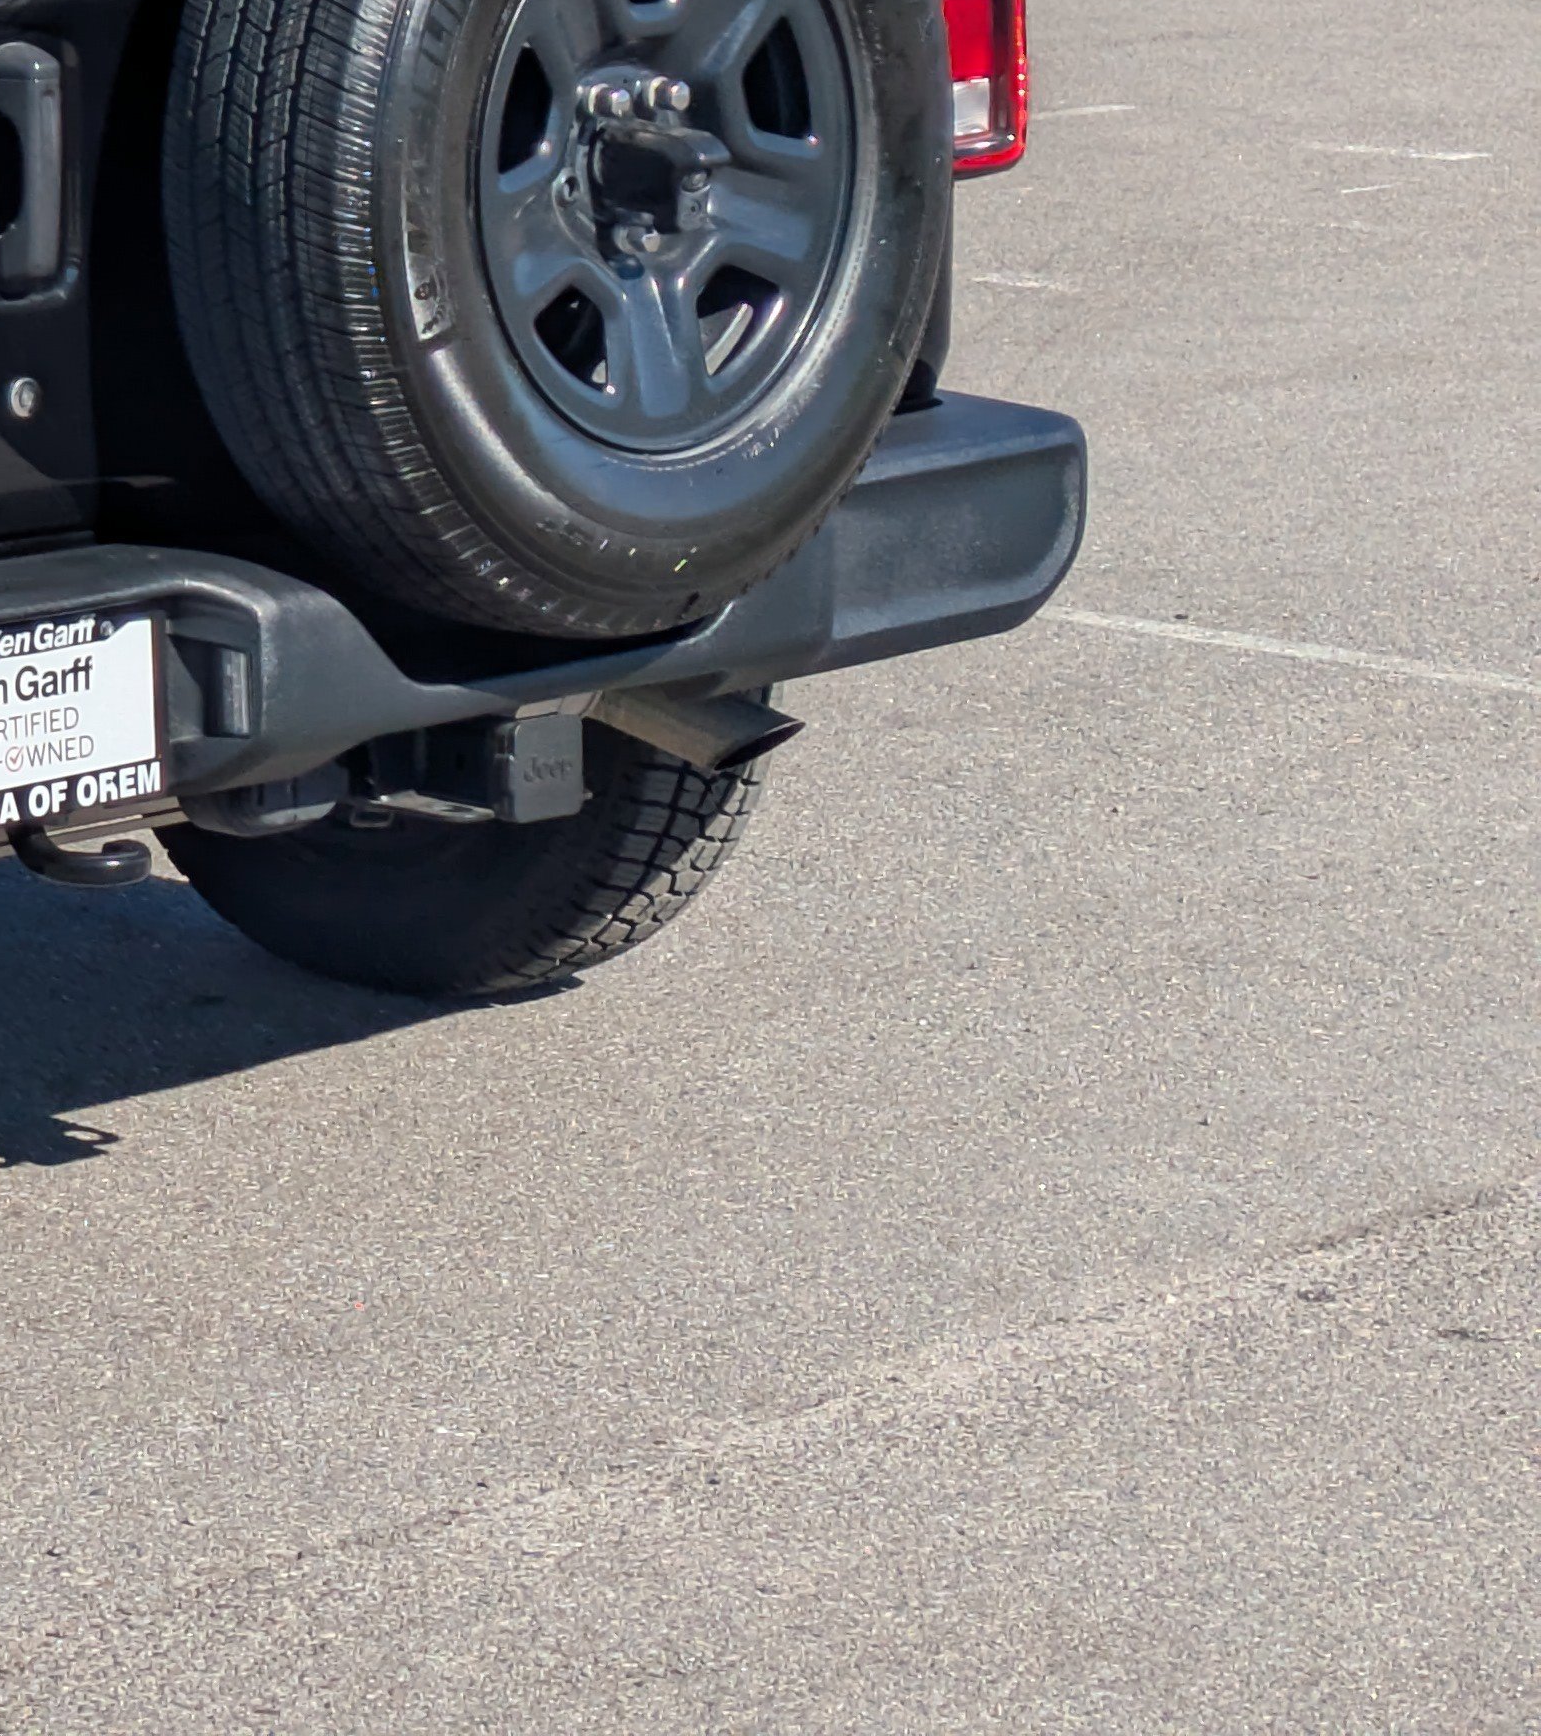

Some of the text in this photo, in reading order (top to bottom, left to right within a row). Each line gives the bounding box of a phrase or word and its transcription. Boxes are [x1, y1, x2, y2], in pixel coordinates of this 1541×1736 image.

[32, 615, 97, 651] Garff
[15, 656, 94, 701] Garff
[28, 781, 69, 817] OF
[77, 762, 162, 808] OREM
